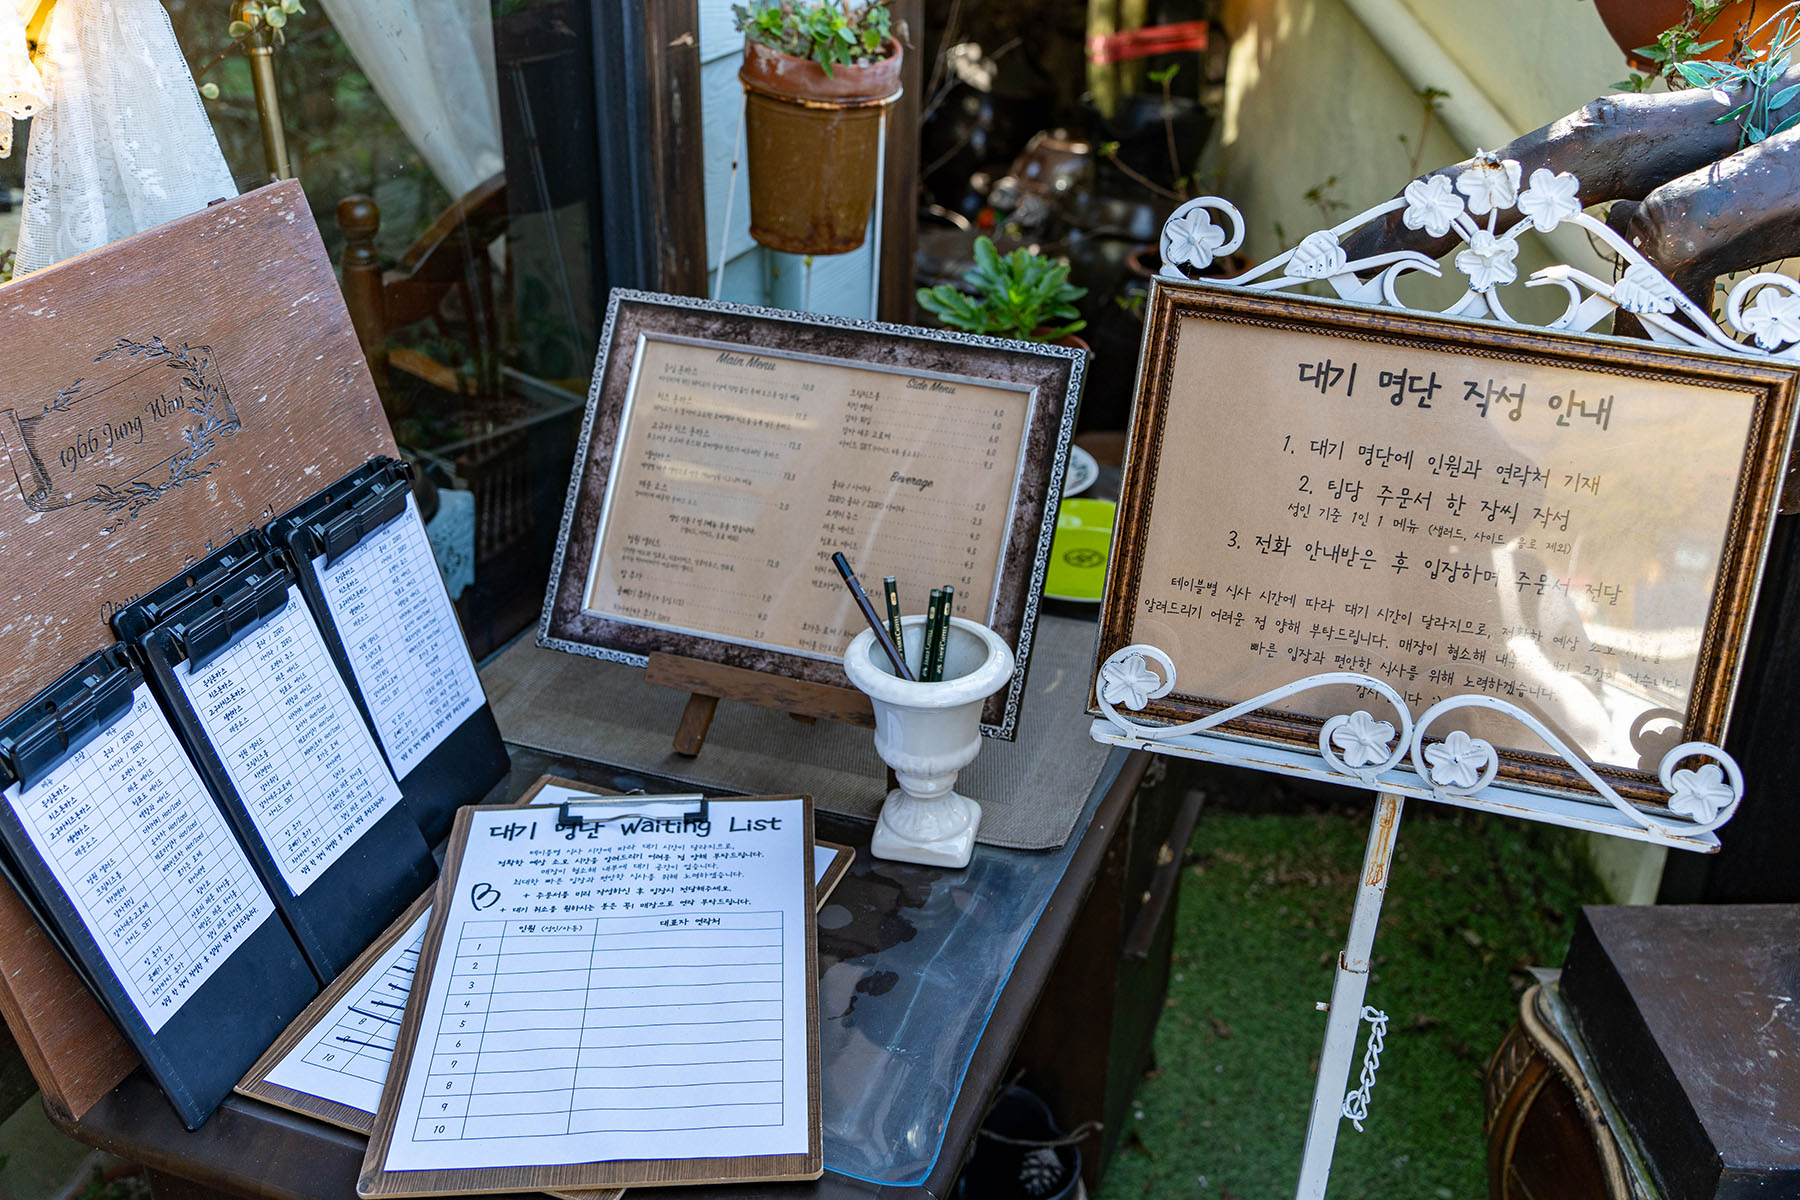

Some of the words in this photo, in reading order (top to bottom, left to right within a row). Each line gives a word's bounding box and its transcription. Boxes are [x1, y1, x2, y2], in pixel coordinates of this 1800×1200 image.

[715, 351, 744, 367] Main
[745, 355, 776, 371] Menu
[905, 377, 928, 390] Side
[928, 381, 956, 395] Menu
[1297, 358, 1358, 398] 대기
[1378, 367, 1443, 410] 명단
[1463, 378, 1527, 423] 작성
[1547, 389, 1615, 432] 안내
[60, 428, 99, 473] 1966
[103, 415, 144, 448] Jung
[144, 394, 185, 422] Won
[1282, 434, 1295, 455] 1.
[1309, 437, 1345, 461] 대기
[1358, 443, 1415, 471] 명단에
[1427, 452, 1483, 481] 인원과
[1495, 462, 1551, 489] 연락처
[1563, 472, 1601, 496] 기재
[889, 471, 934, 493] Beverage
[1298, 474, 1313, 495] 2.
[1327, 477, 1365, 503] 팀당
[1376, 484, 1433, 512] 주문서
[1445, 492, 1467, 517] 한
[1480, 499, 1520, 526] 장씩
[1532, 506, 1571, 533] 작성
[1287, 501, 1312, 519] 성인
[1318, 506, 1343, 524] 기준
[1351, 511, 1370, 527] 1인
[1392, 517, 1420, 535] 메뉴
[1427, 523, 1467, 542] (샐러드,
[1473, 531, 1504, 545] 사이드
[1226, 529, 1241, 550] 3.
[1255, 533, 1293, 558] 전화
[1304, 539, 1377, 571] 안내받은
[1390, 550, 1410, 575] 후
[1424, 558, 1499, 588] 입장하며
[1514, 567, 1572, 599] 주문서
[1584, 581, 1624, 607] 전달
[1225, 584, 1252, 601] 식사
[1258, 589, 1297, 609] 시간에
[1305, 596, 1336, 614] 따라
[1344, 602, 1370, 619] 대기
[1376, 607, 1413, 626] 시간이
[1421, 613, 1491, 640] 달라지므로,
[1144, 597, 1203, 620] 알려드리기
[1210, 608, 1246, 627] 어려운
[1275, 617, 1301, 636] 양해
[1308, 623, 1389, 649] 부탁드립니다.
[1398, 638, 1438, 657] 매장이
[1447, 643, 1487, 664] 협소해
[1249, 641, 1279, 659] 빠른
[1287, 645, 1327, 666] 입장과
[1333, 653, 1373, 674] 편안한
[1377, 657, 1420, 682] 식사를
[1427, 667, 1455, 687] 위해
[1462, 674, 1562, 706] 노력하겠습니다.
[489, 821, 538, 842] 대기
[728, 816, 783, 833] List
[659, 917, 690, 927] 대표자
[694, 917, 721, 927] 연락처
[472, 961, 479, 970] 2
[468, 980, 475, 990] 3
[463, 1000, 471, 1008] 4
[459, 1019, 467, 1028] 5
[455, 1039, 462, 1049] 6
[322, 1053, 335, 1062] 10
[450, 1060, 458, 1069] 7
[445, 1080, 453, 1090] 8
[441, 1102, 449, 1112] 9
[433, 1124, 446, 1134] 10
